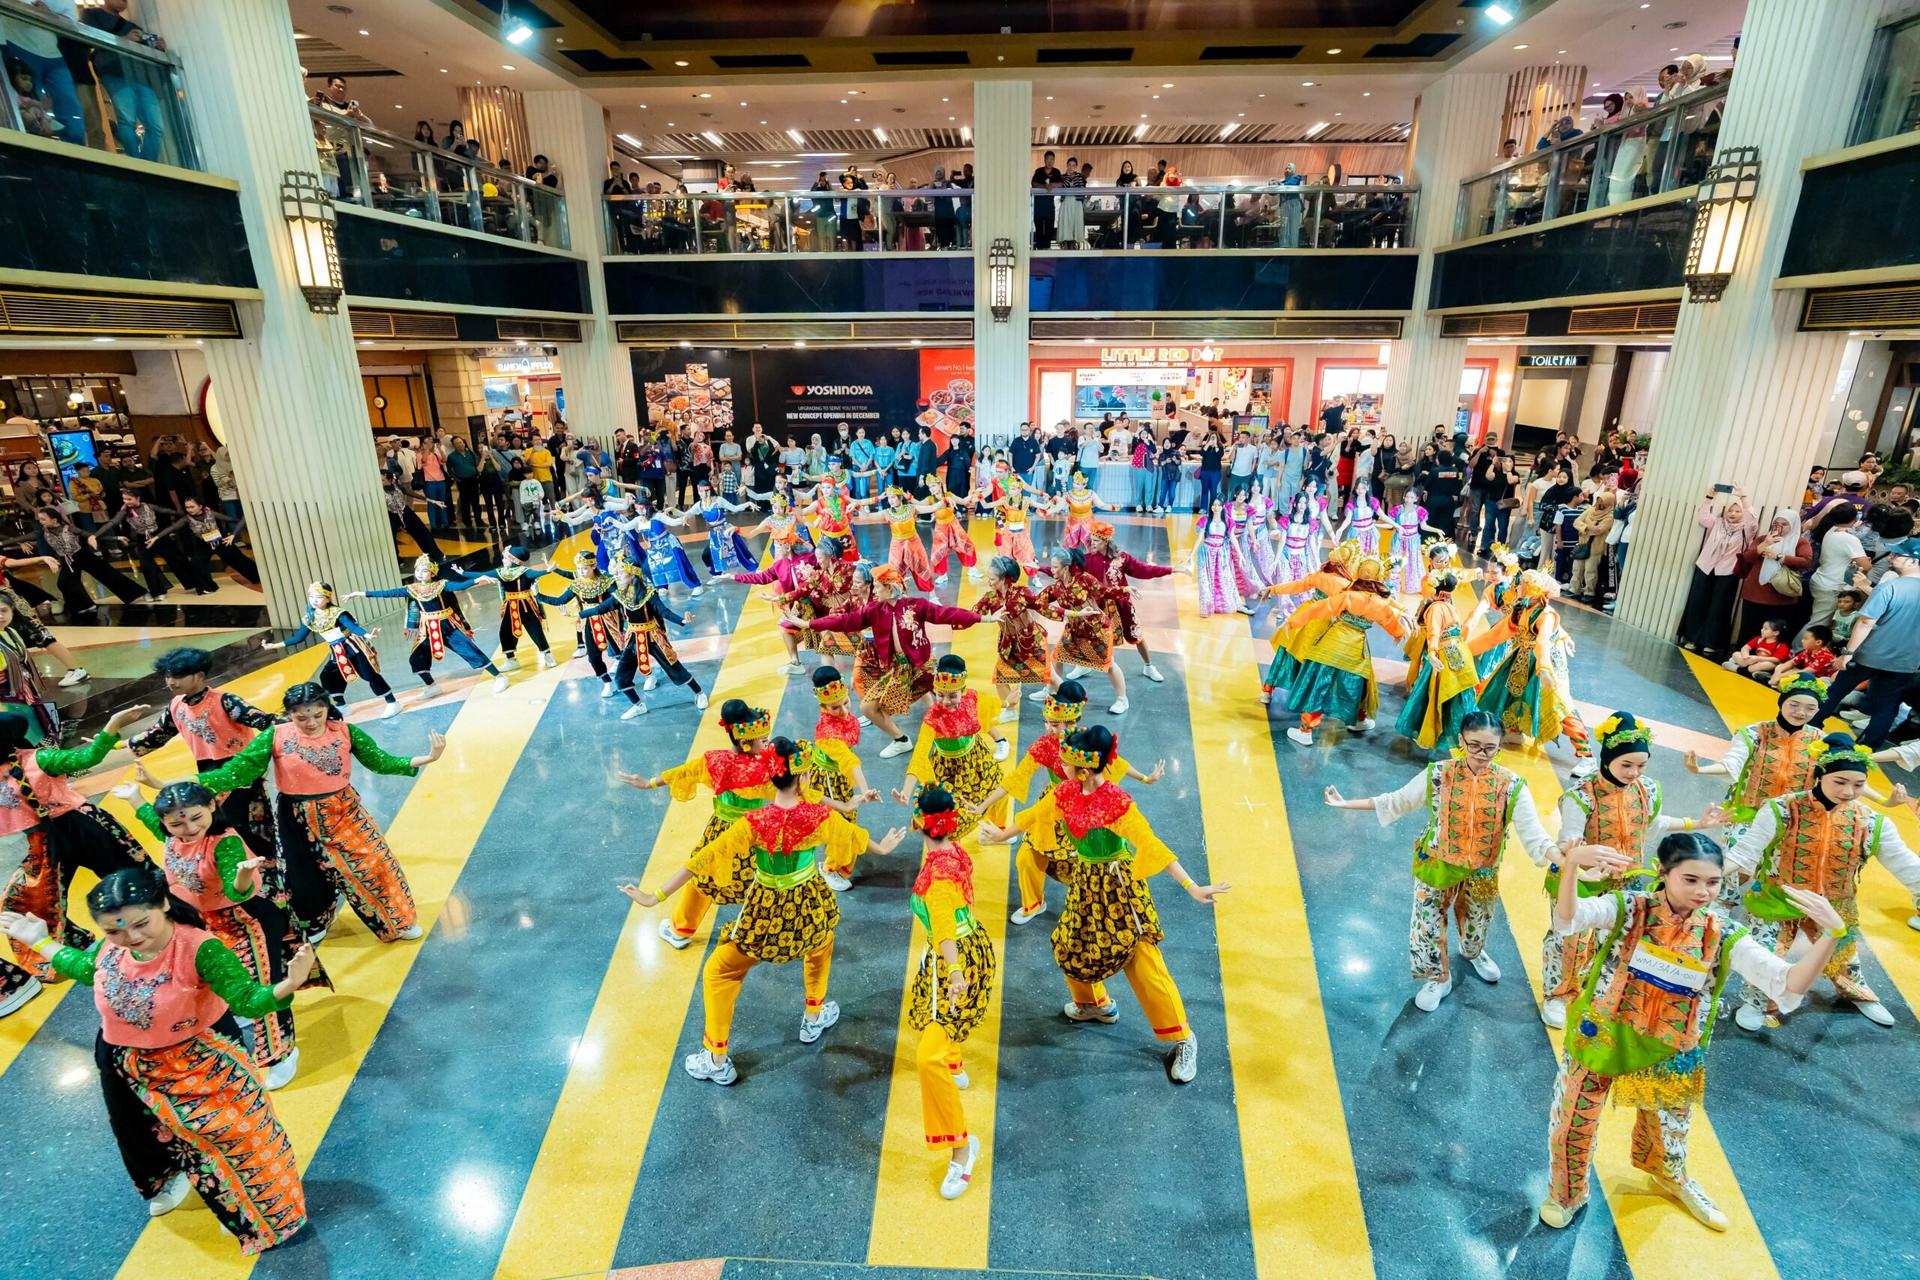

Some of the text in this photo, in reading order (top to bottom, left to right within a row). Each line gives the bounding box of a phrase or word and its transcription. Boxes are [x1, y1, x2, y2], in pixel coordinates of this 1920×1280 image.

[1101, 348, 1155, 361] LITTLE
[1159, 348, 1189, 361] RED
[1531, 355, 1564, 366] TOILET
[806, 385, 873, 396] YOSHINOYA
